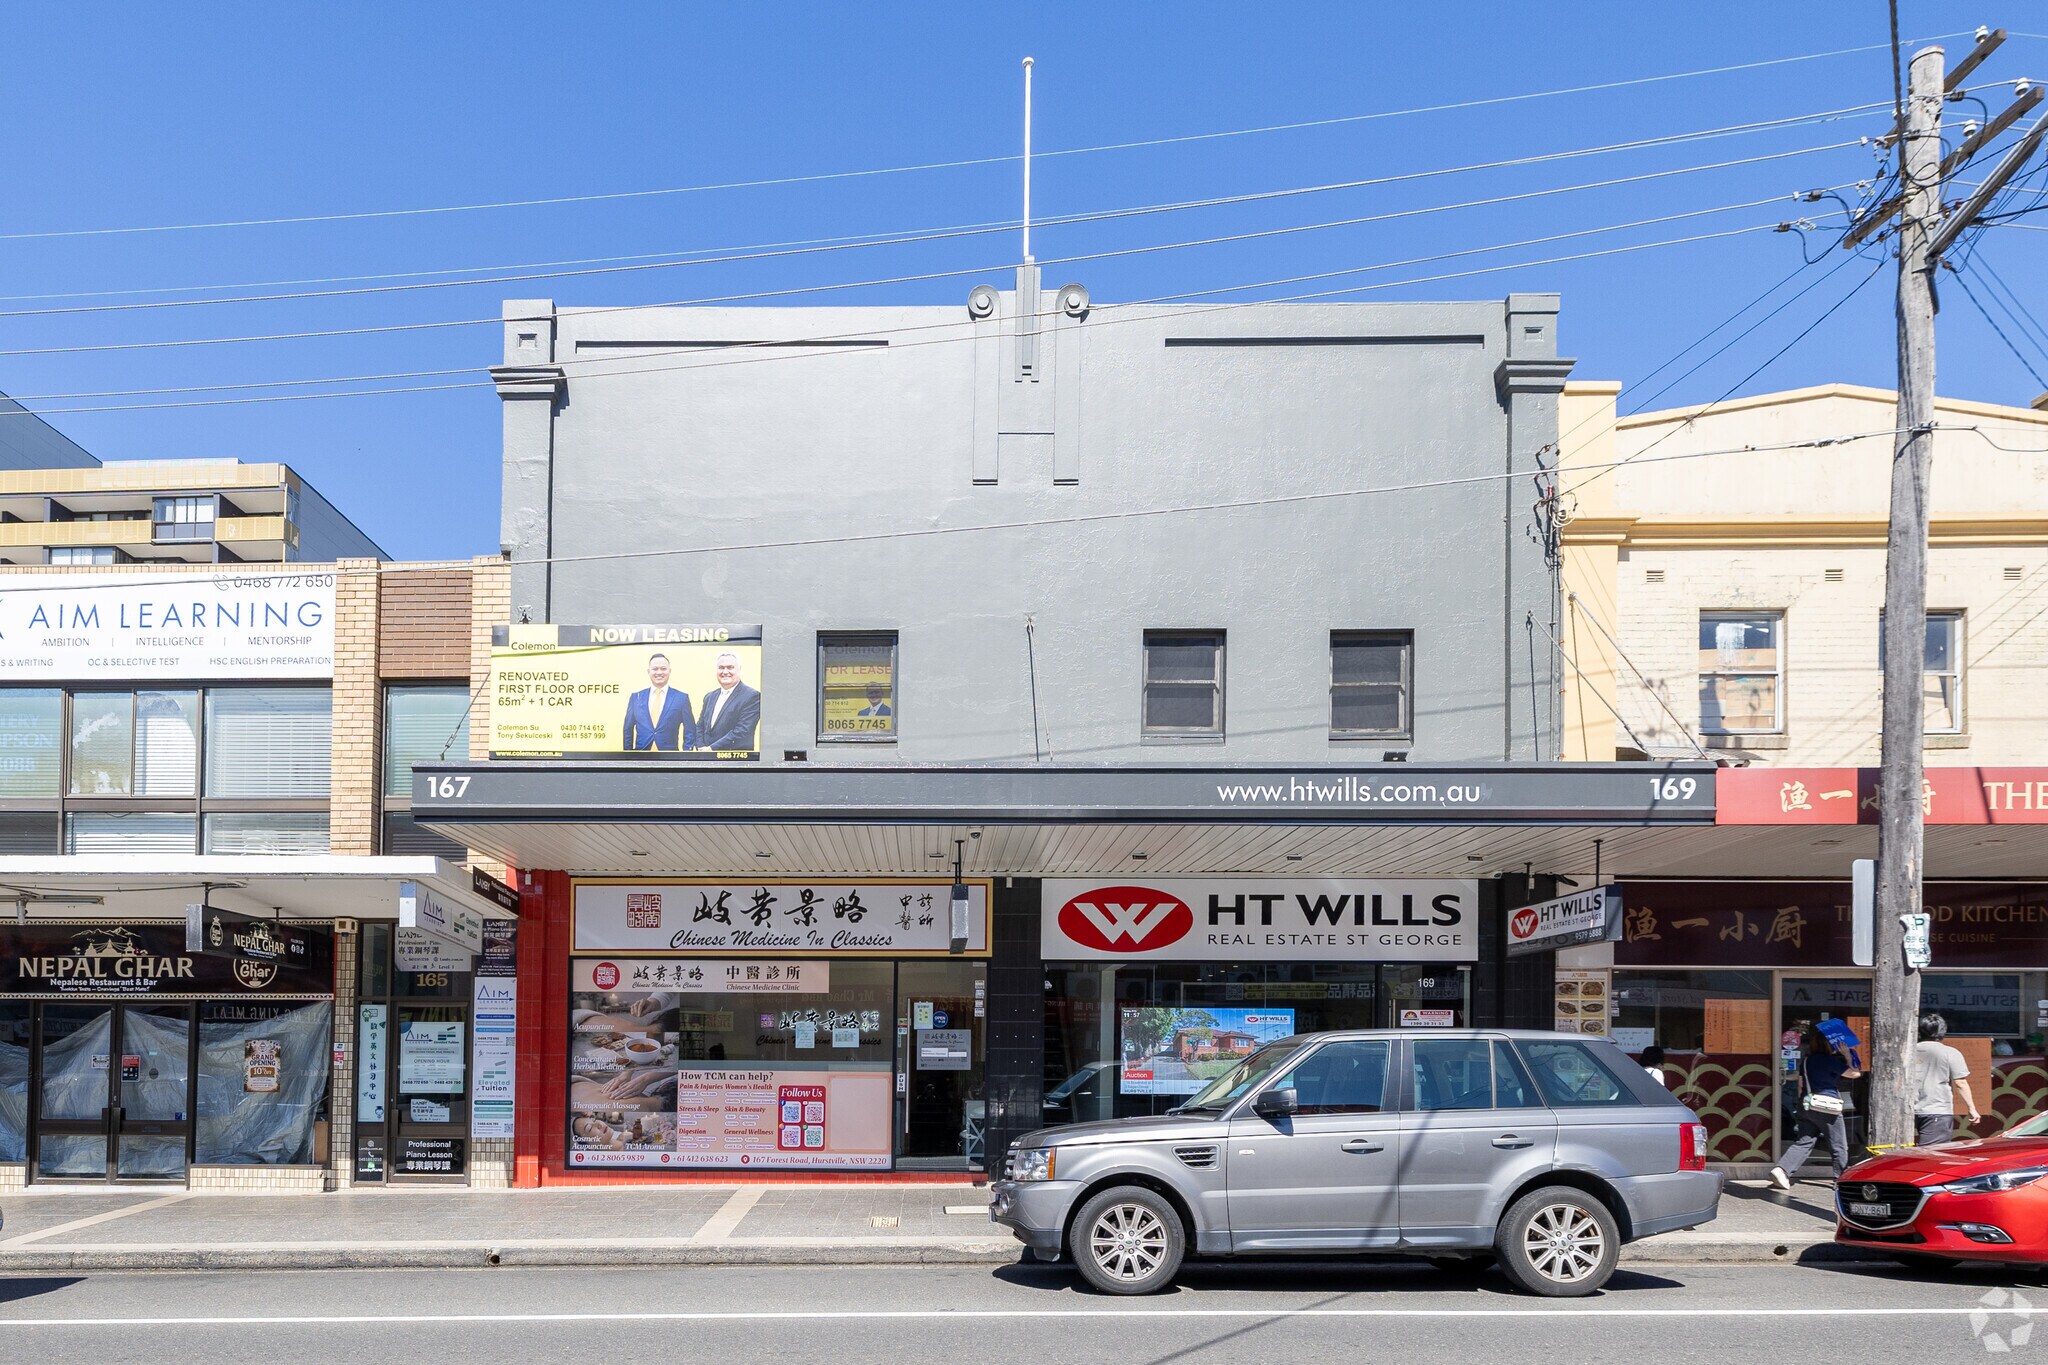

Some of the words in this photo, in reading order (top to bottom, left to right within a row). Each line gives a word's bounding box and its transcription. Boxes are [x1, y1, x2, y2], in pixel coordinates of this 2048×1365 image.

[305, 575, 333, 588] 650
[28, 604, 99, 629] AIM
[121, 602, 323, 628] LEARNING
[590, 629, 637, 642] NOW
[643, 628, 729, 642] LEASING
[41, 637, 90, 647] AMBITION
[136, 637, 204, 646] INTELLIGENCE
[248, 636, 312, 646] MENTORSHIP
[511, 641, 556, 651] Colemon
[16, 659, 54, 667] WRITING
[87, 658, 101, 667] OC
[102, 658, 109, 667] &
[111, 658, 157, 667] SELECTIVE
[159, 657, 180, 666] TEST
[209, 657, 232, 666] HSC
[233, 657, 268, 666] ENGLISH
[270, 656, 331, 666] PREPARATION
[852, 665, 892, 675] LEASE
[499, 671, 569, 681] RENOVATED
[499, 684, 532, 694] FIRST
[535, 684, 574, 694] FLOOR
[579, 684, 620, 694] OFFICE
[548, 697, 573, 706] CAR
[828, 719, 855, 729] 8065
[859, 719, 886, 729] 7745
[497, 733, 514, 741] Tony
[427, 776, 471, 797] 167
[1218, 777, 1481, 803] www.htwills.com.au
[1650, 778, 1697, 801] 169
[1983, 782, 2048, 810] THE
[1208, 894, 1285, 925] HT
[1295, 894, 1462, 926] WILLS
[1541, 904, 1559, 922] HT
[1561, 893, 1602, 917] WILLS
[1961, 904, 2048, 922] KITCHEN
[1541, 923, 1552, 931] REAL
[1554, 920, 1571, 929] ESTATE
[670, 930, 727, 950] Chinese
[731, 930, 800, 947] Medicine
[807, 930, 825, 947] In
[831, 929, 893, 949] Classics
[1208, 934, 1256, 945] REAL
[1266, 934, 1337, 945] ESTATE
[1347, 934, 1369, 945] ST
[1379, 934, 1462, 946] GEORGE
[1575, 931, 1589, 940] 9579
[1949, 934, 1996, 943] CUISINE
[233, 934, 262, 951] NEPAL
[262, 939, 286, 955] GHAR
[19, 957, 108, 978] NEPAL
[115, 957, 195, 978] GHAR
[240, 964, 271, 978] Ghar
[50, 978, 87, 987] Nepalese
[89, 978, 134, 986] Restaurant
[136, 978, 142, 986] &
[143, 978, 157, 986] Bar
[417, 973, 448, 987] 165
[1418, 977, 1435, 988] 169
[726, 983, 752, 991] Chinese
[573, 1023, 615, 1031] Acupuncture
[756, 1034, 788, 1046] Chinese
[573, 1055, 617, 1063] Concentrated
[573, 1063, 597, 1071] Herbal
[681, 1072, 703, 1080] How
[704, 1072, 727, 1080] TCM
[748, 1072, 774, 1082] help?
[781, 1088, 811, 1097] Follow
[812, 1088, 823, 1097] Us
[573, 1102, 611, 1110] Therapeutic
[612, 1102, 640, 1110] Massage
[408, 1140, 451, 1148] Professional
[572, 1135, 602, 1143] Cosmetic
[789, 1156, 811, 1164] Road,
[812, 1156, 847, 1165] Hurstville,
[406, 1161, 451, 1171] 專業鋼琴課
